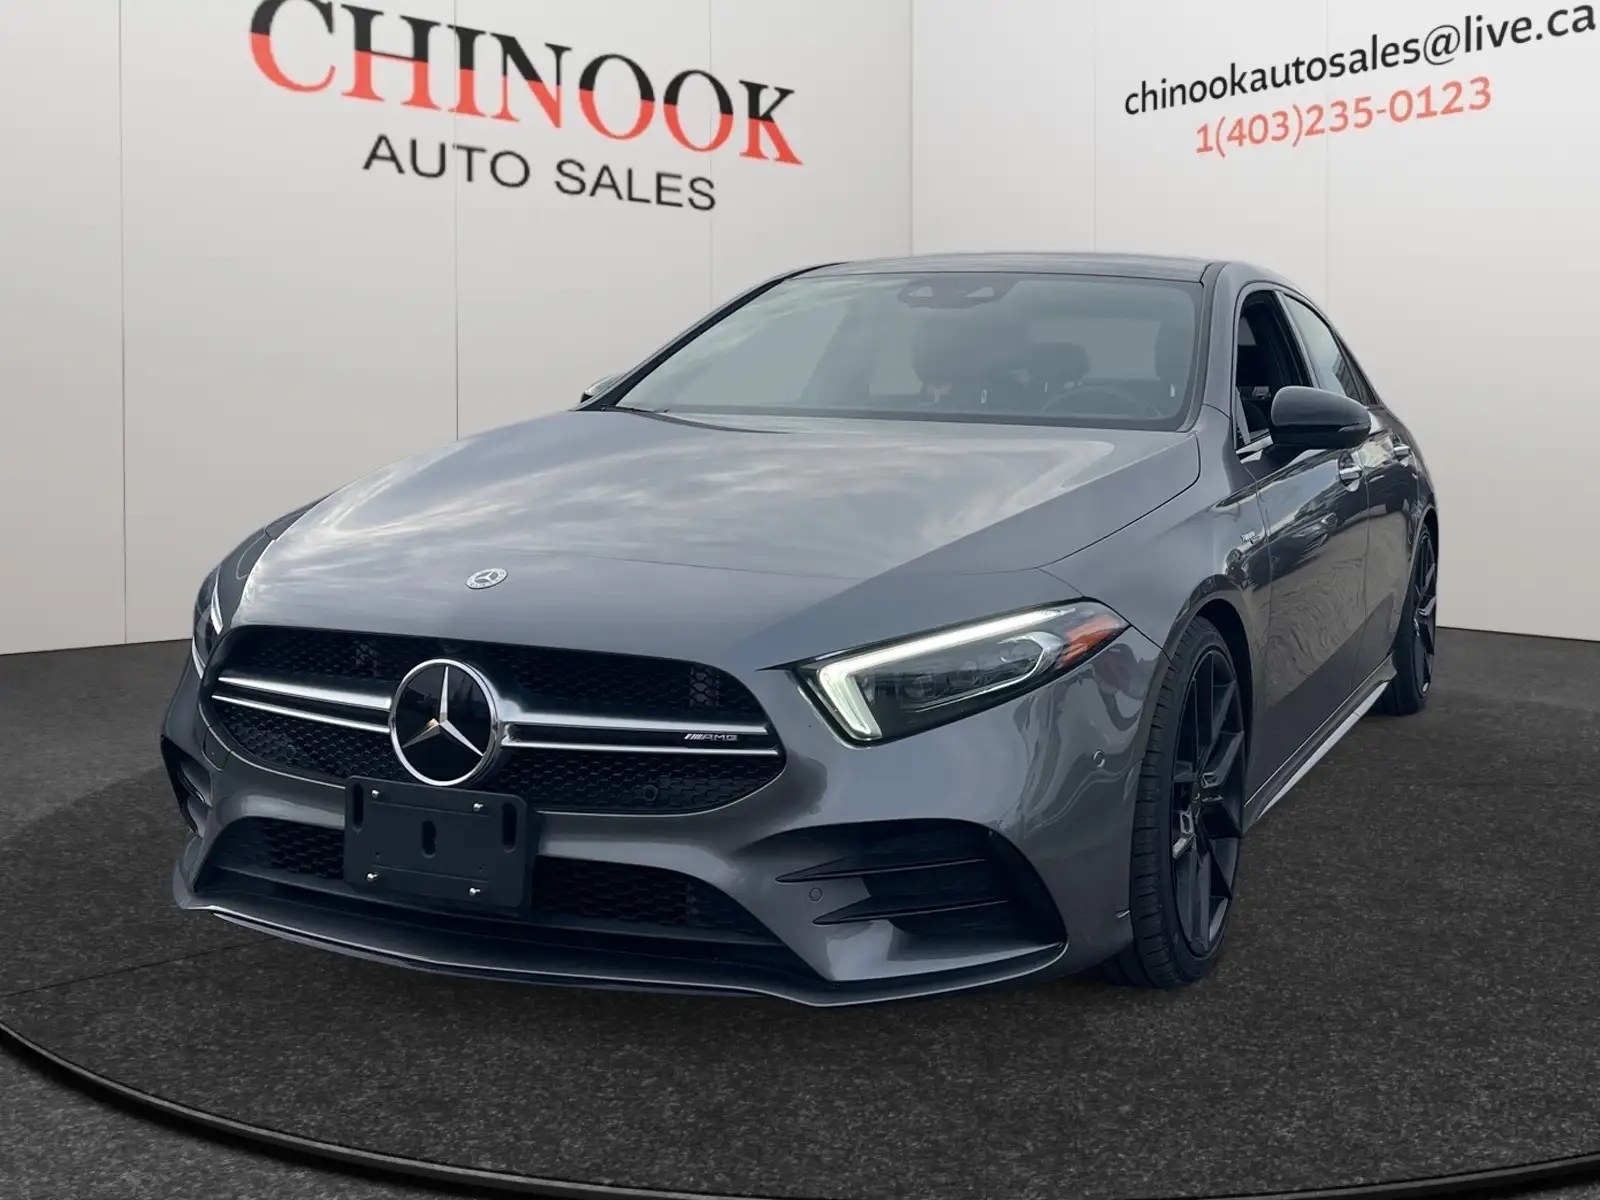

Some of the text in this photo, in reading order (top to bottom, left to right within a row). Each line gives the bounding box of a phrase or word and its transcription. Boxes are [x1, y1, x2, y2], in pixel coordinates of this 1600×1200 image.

[250, 0, 803, 165] CHINOOK
[1124, 4, 1596, 115] chinookautosales@live.ca
[1195, 76, 1492, 158] 1(403)235-0123
[362, 134, 716, 211] AUTO SALES
